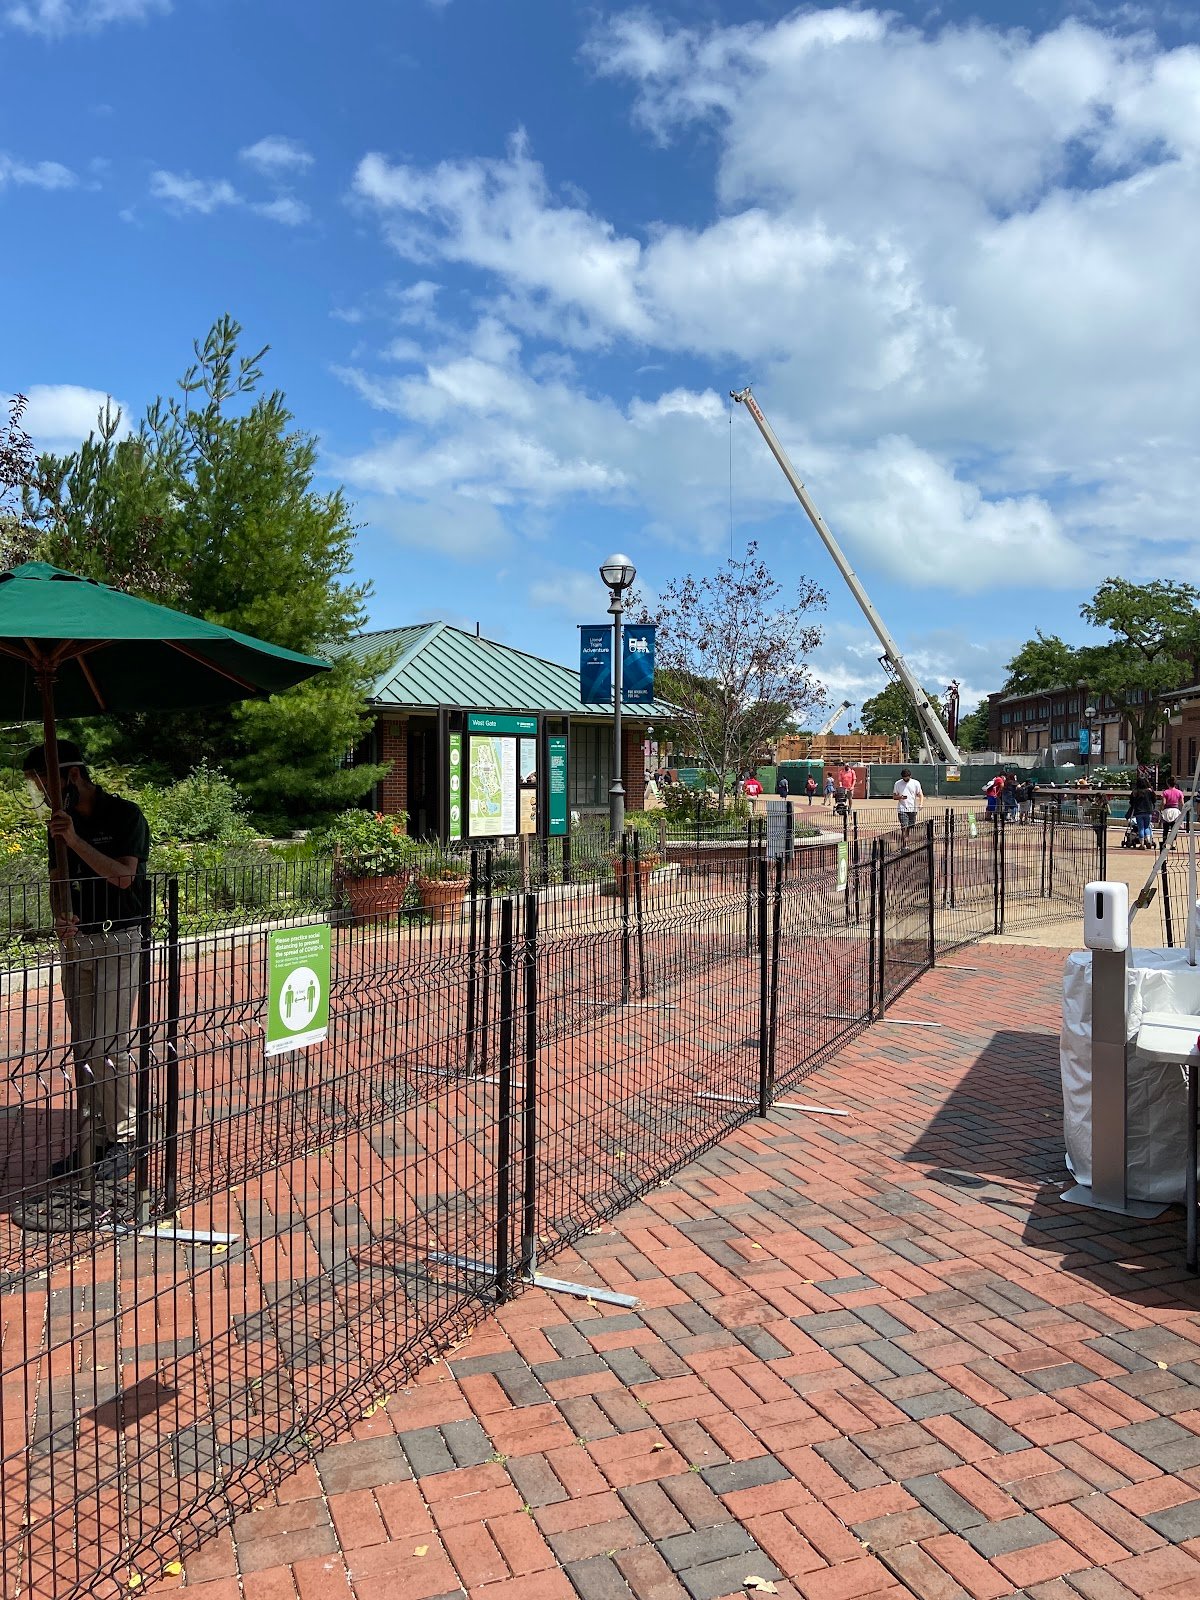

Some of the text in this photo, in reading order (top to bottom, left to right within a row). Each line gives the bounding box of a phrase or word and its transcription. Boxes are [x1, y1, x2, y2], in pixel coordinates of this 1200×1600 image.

[290, 935, 307, 943] practice
[275, 943, 298, 951] distancing
[303, 939, 320, 947] prevent
[283, 948, 299, 957] spread
